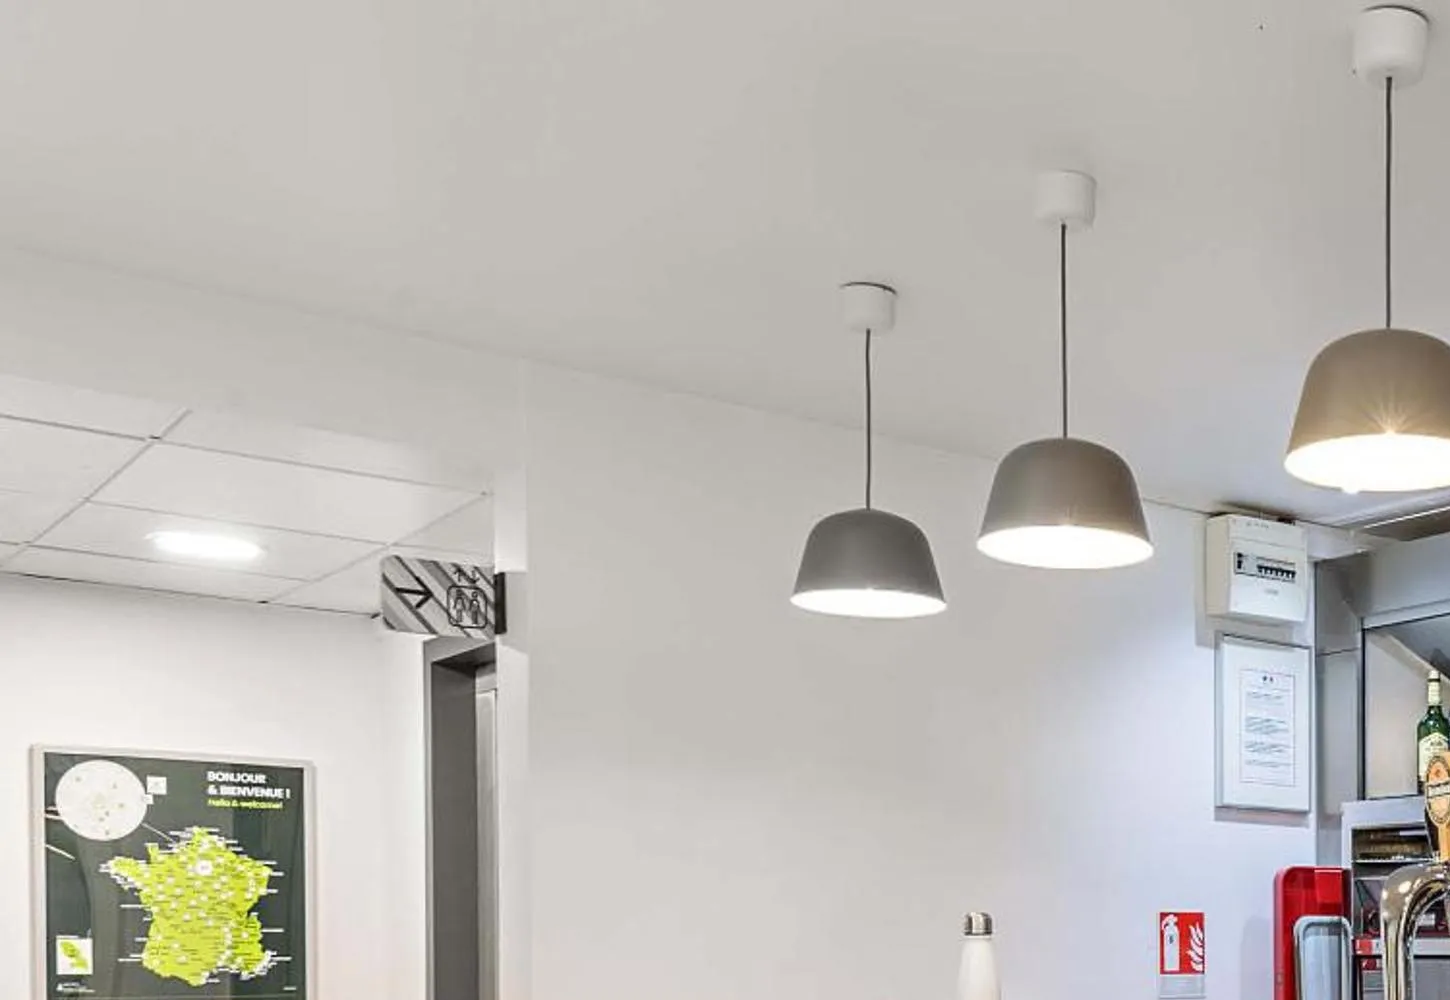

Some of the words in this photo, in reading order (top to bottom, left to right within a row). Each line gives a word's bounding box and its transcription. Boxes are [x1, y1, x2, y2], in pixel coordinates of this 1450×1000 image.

[207, 770, 267, 784] BONJOUR
[208, 784, 217, 796] &
[220, 785, 285, 799] BIENVENUE
